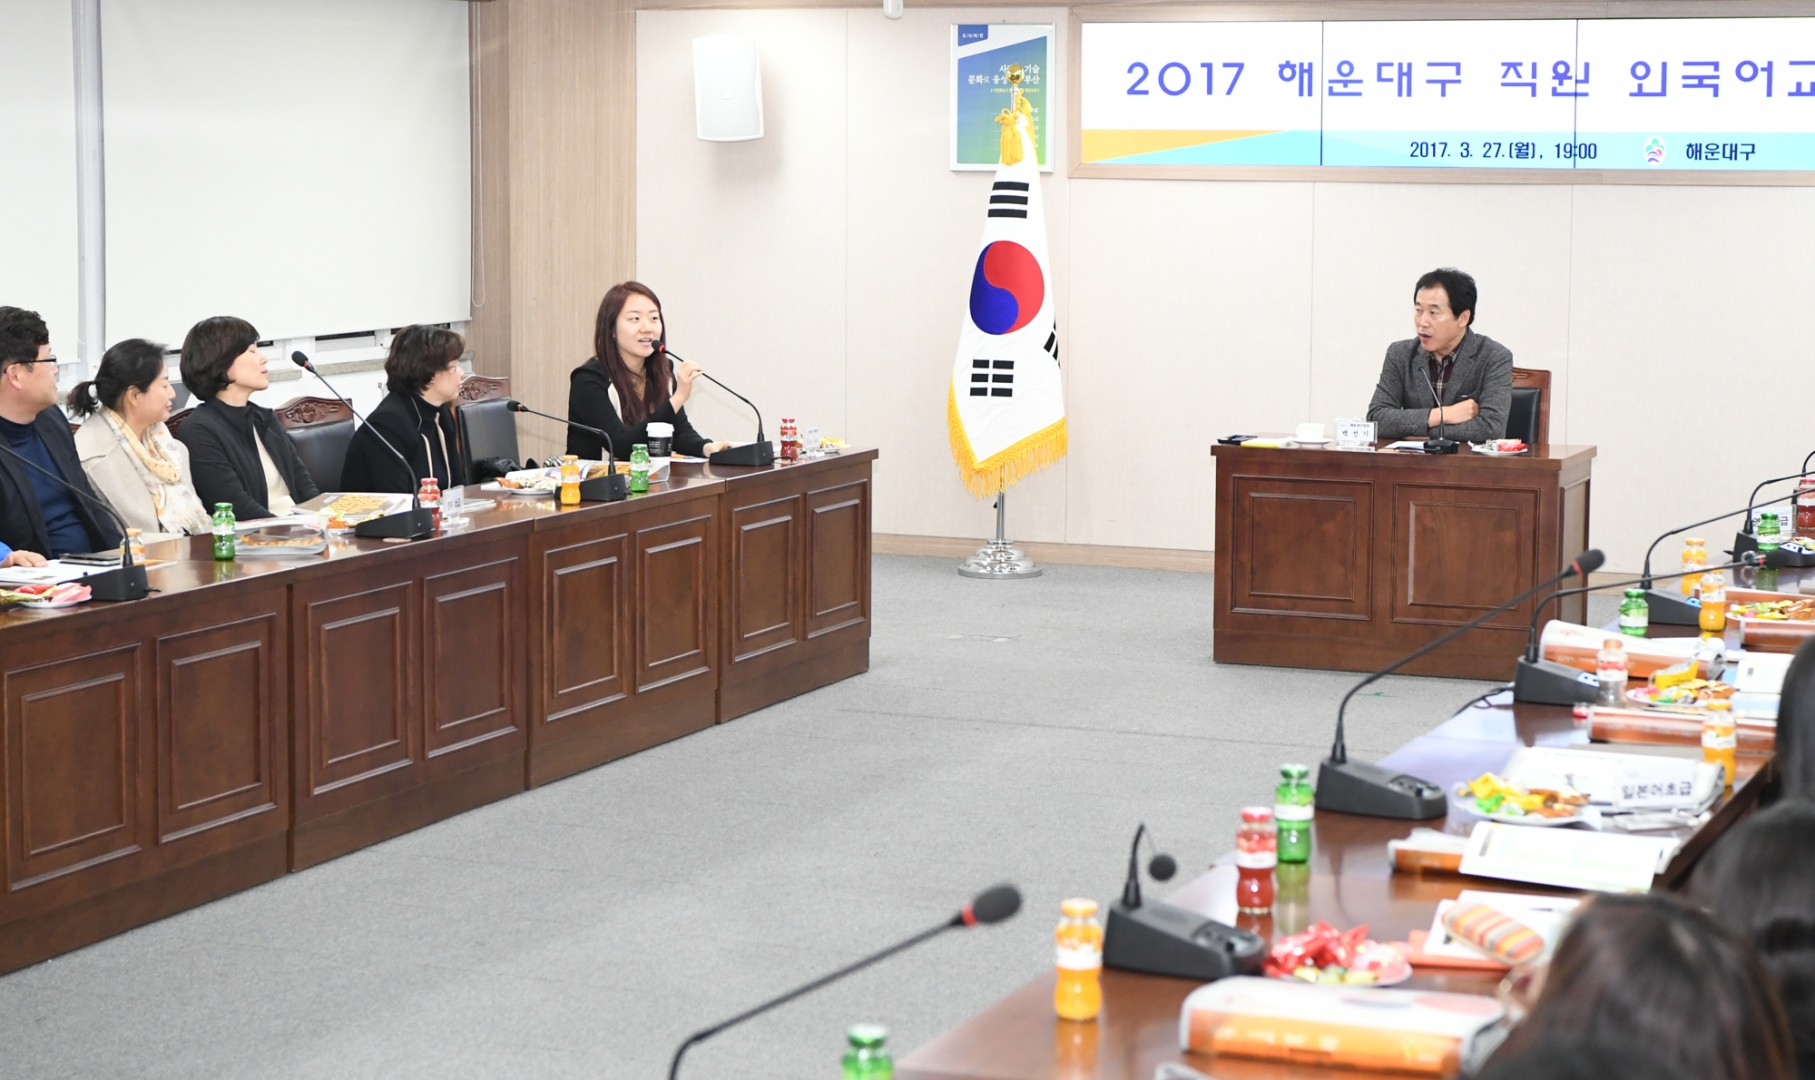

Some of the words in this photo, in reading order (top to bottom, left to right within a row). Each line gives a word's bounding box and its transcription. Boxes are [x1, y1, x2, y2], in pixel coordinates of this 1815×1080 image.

[1023, 74, 1041, 85] 부산
[1126, 61, 1245, 96] 2017
[1278, 60, 1462, 97] 해운대구
[1500, 60, 1590, 97] 직원
[1409, 141, 1451, 158] 2017.
[1459, 141, 1474, 158] 3.
[1554, 142, 1598, 160] 19:00
[1685, 142, 1756, 161] 해운대구
[1621, 781, 1692, 800] 일본어초급
